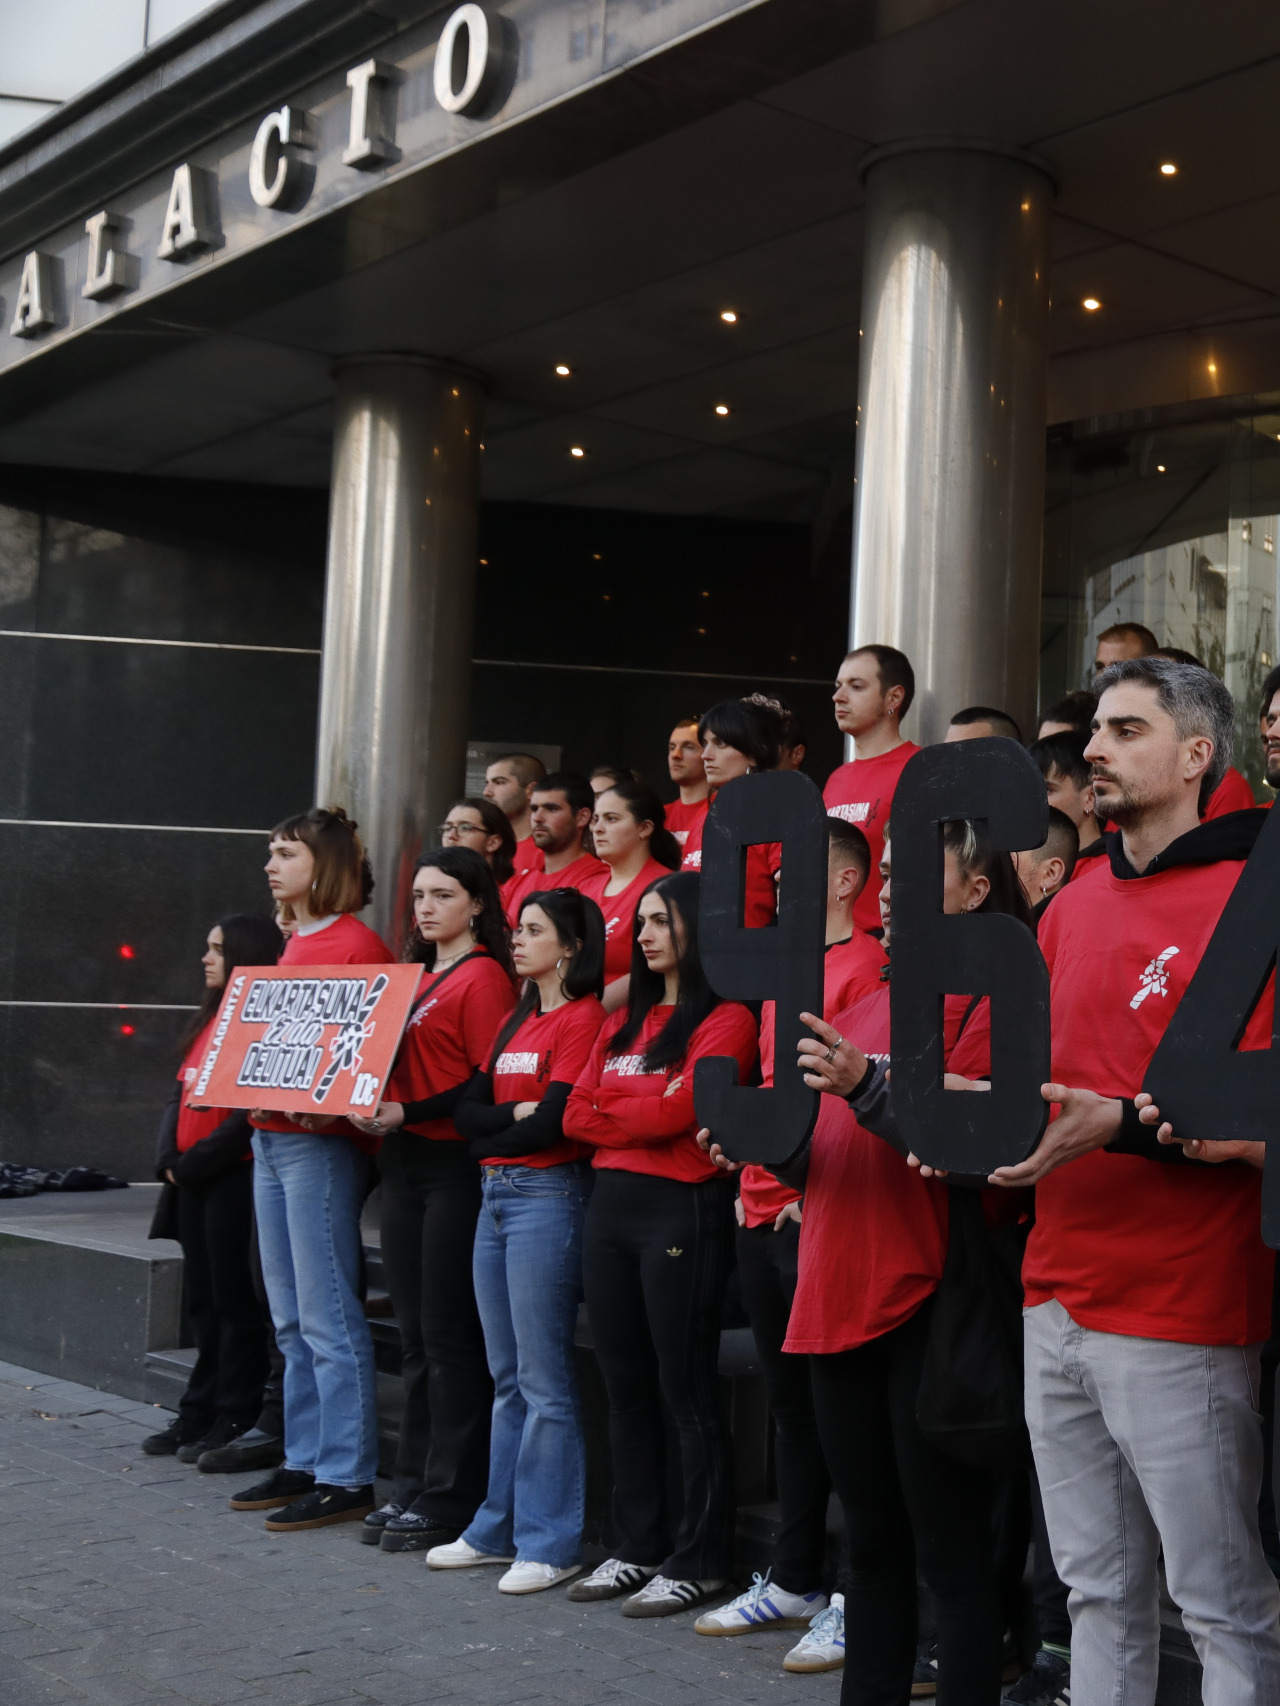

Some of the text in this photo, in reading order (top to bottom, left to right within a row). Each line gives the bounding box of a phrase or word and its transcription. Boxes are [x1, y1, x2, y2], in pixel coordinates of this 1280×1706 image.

[10, 3, 490, 340] ALACIO
[241, 978, 367, 1024] ELKARTASUNA
[236, 1042, 324, 1090] DELITUA!
